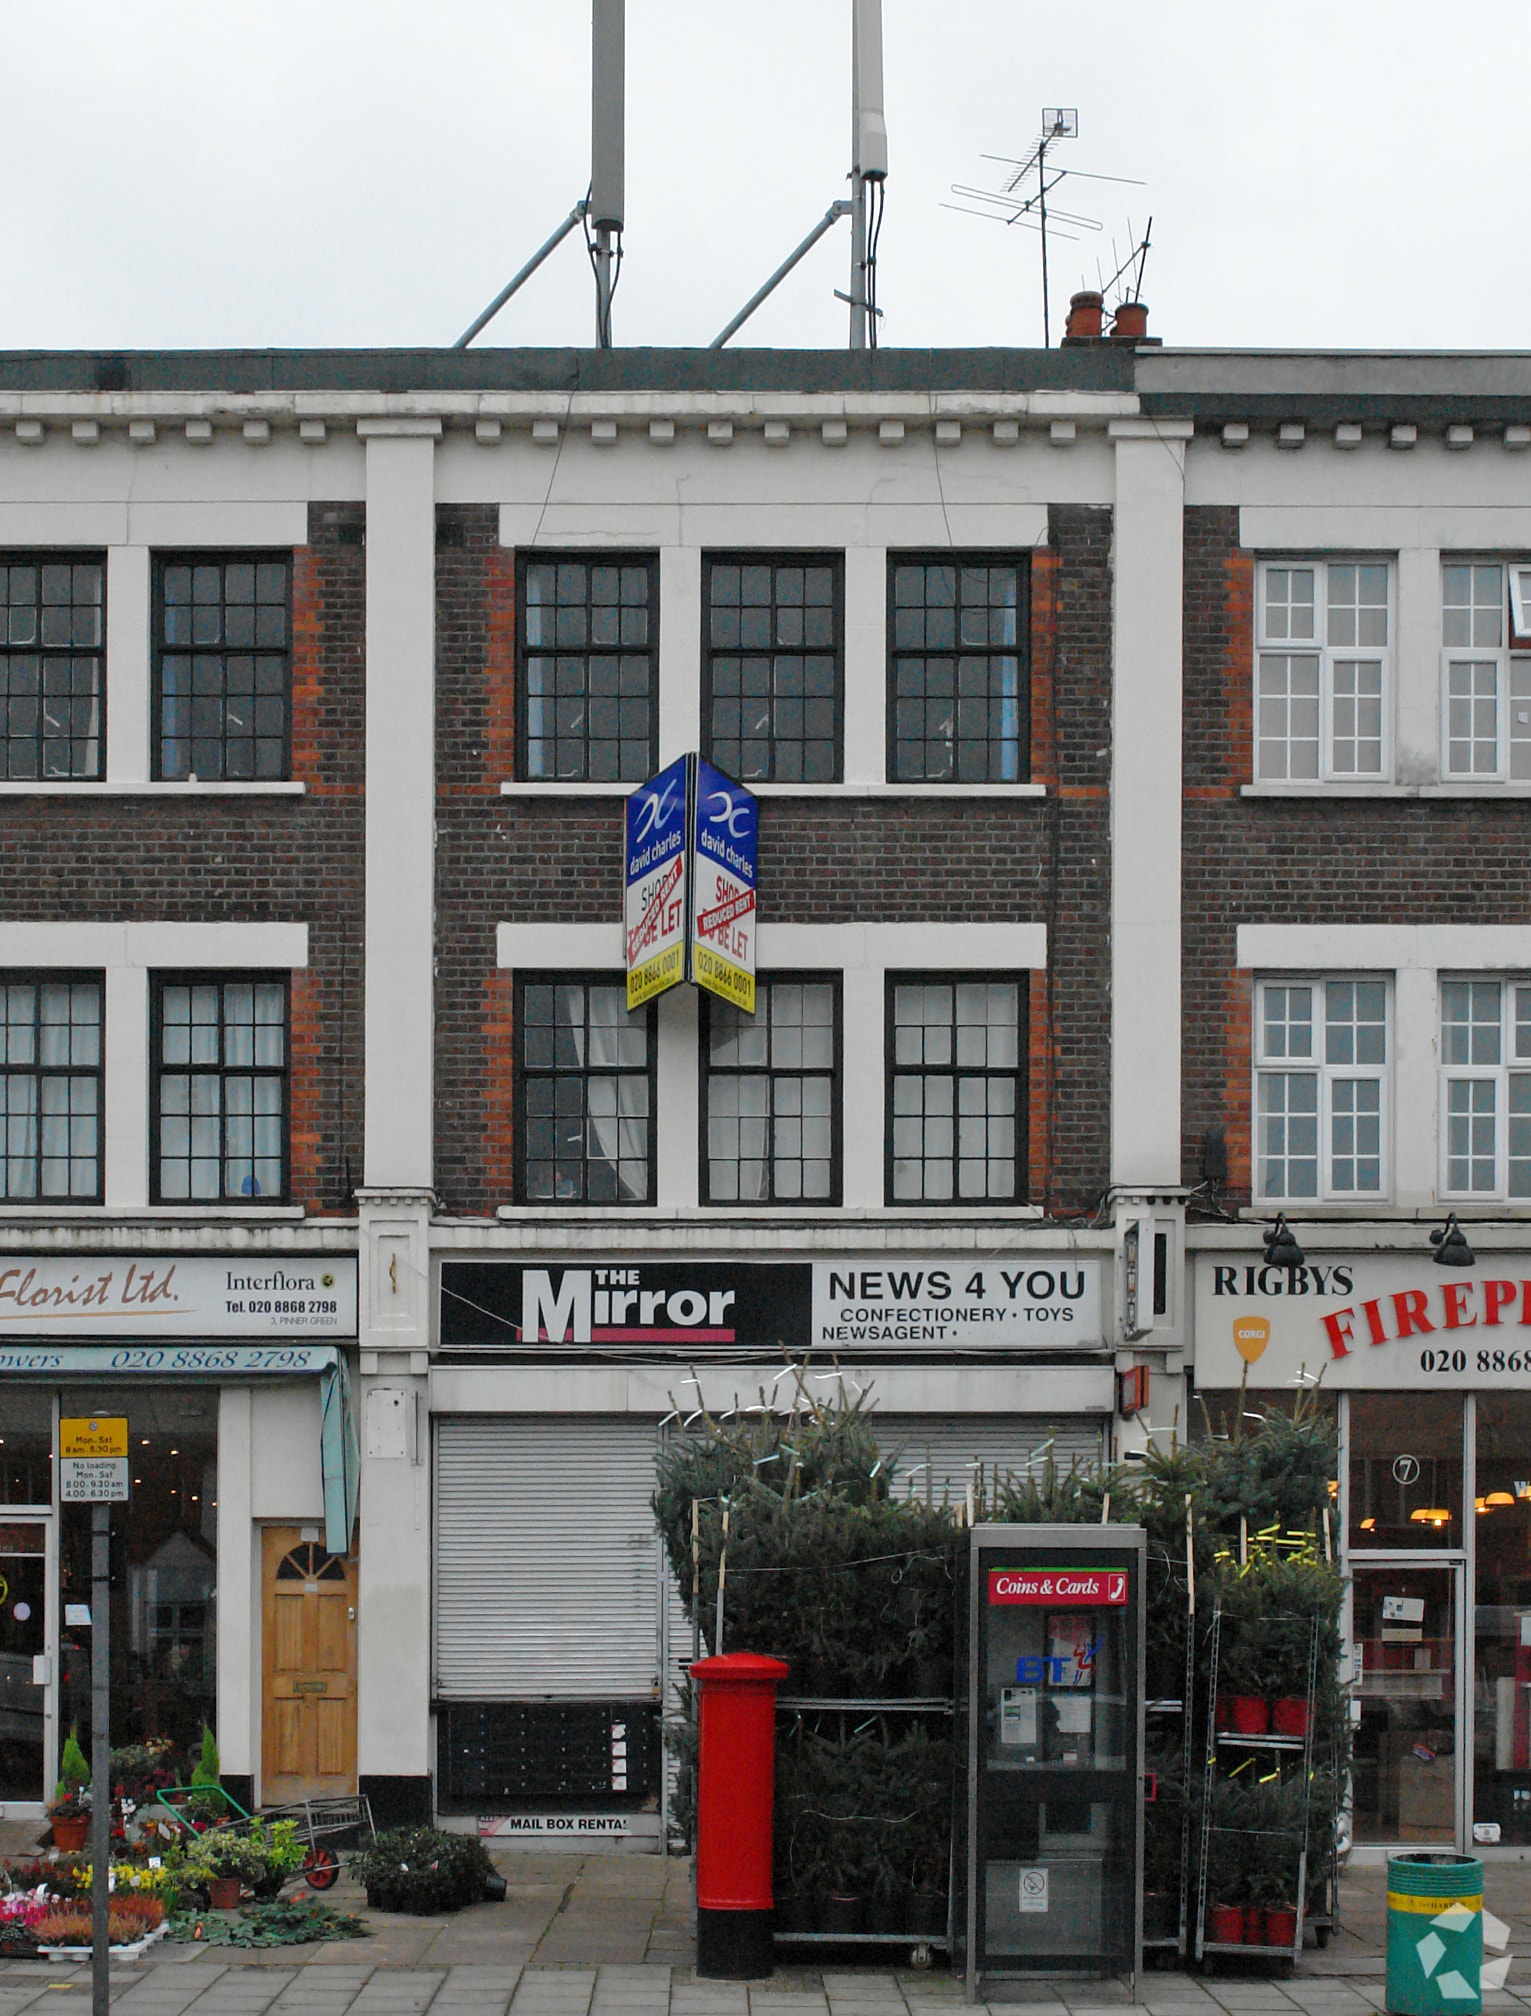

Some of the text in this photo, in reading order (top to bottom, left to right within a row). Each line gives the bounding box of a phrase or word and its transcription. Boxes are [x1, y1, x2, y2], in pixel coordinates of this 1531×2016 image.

[630, 830, 681, 876] david charles
[702, 828, 753, 879] david charles
[661, 898, 682, 938] LET
[732, 926, 749, 962] LET
[698, 951, 713, 976] 020
[715, 960, 732, 987] 8866
[630, 971, 643, 995] 020
[0, 1264, 179, 1307] Florist Ltd.
[226, 1270, 316, 1291] Interflora
[595, 1269, 640, 1285] THE
[829, 1271, 1085, 1300] NEWS 4 YOU
[1212, 1265, 1354, 1296] RIGBYS
[225, 1300, 337, 1313] Tel. 020 8868 2798
[522, 1269, 736, 1344] Mirror
[840, 1308, 1074, 1322] CONFECTIONERY TOYS
[279, 1316, 308, 1325] PINNER
[309, 1316, 337, 1325] GREEN
[822, 1326, 948, 1340] NEWSAGENT
[1238, 1330, 1265, 1339] CORGI
[111, 1351, 165, 1368] 020
[171, 1351, 239, 1368] 8868
[244, 1351, 312, 1368] 2798
[1420, 1349, 1467, 1373] 020
[76, 1436, 93, 1444] Mon
[98, 1436, 113, 1444] Sat
[87, 1462, 117, 1471] loading
[1399, 1459, 1412, 1481] 7
[996, 1577, 1100, 1595] Coins & Cards
[1015, 1655, 1072, 1684] BT
[510, 1818, 543, 1829] MAIL
[546, 1818, 574, 1829] BOX
